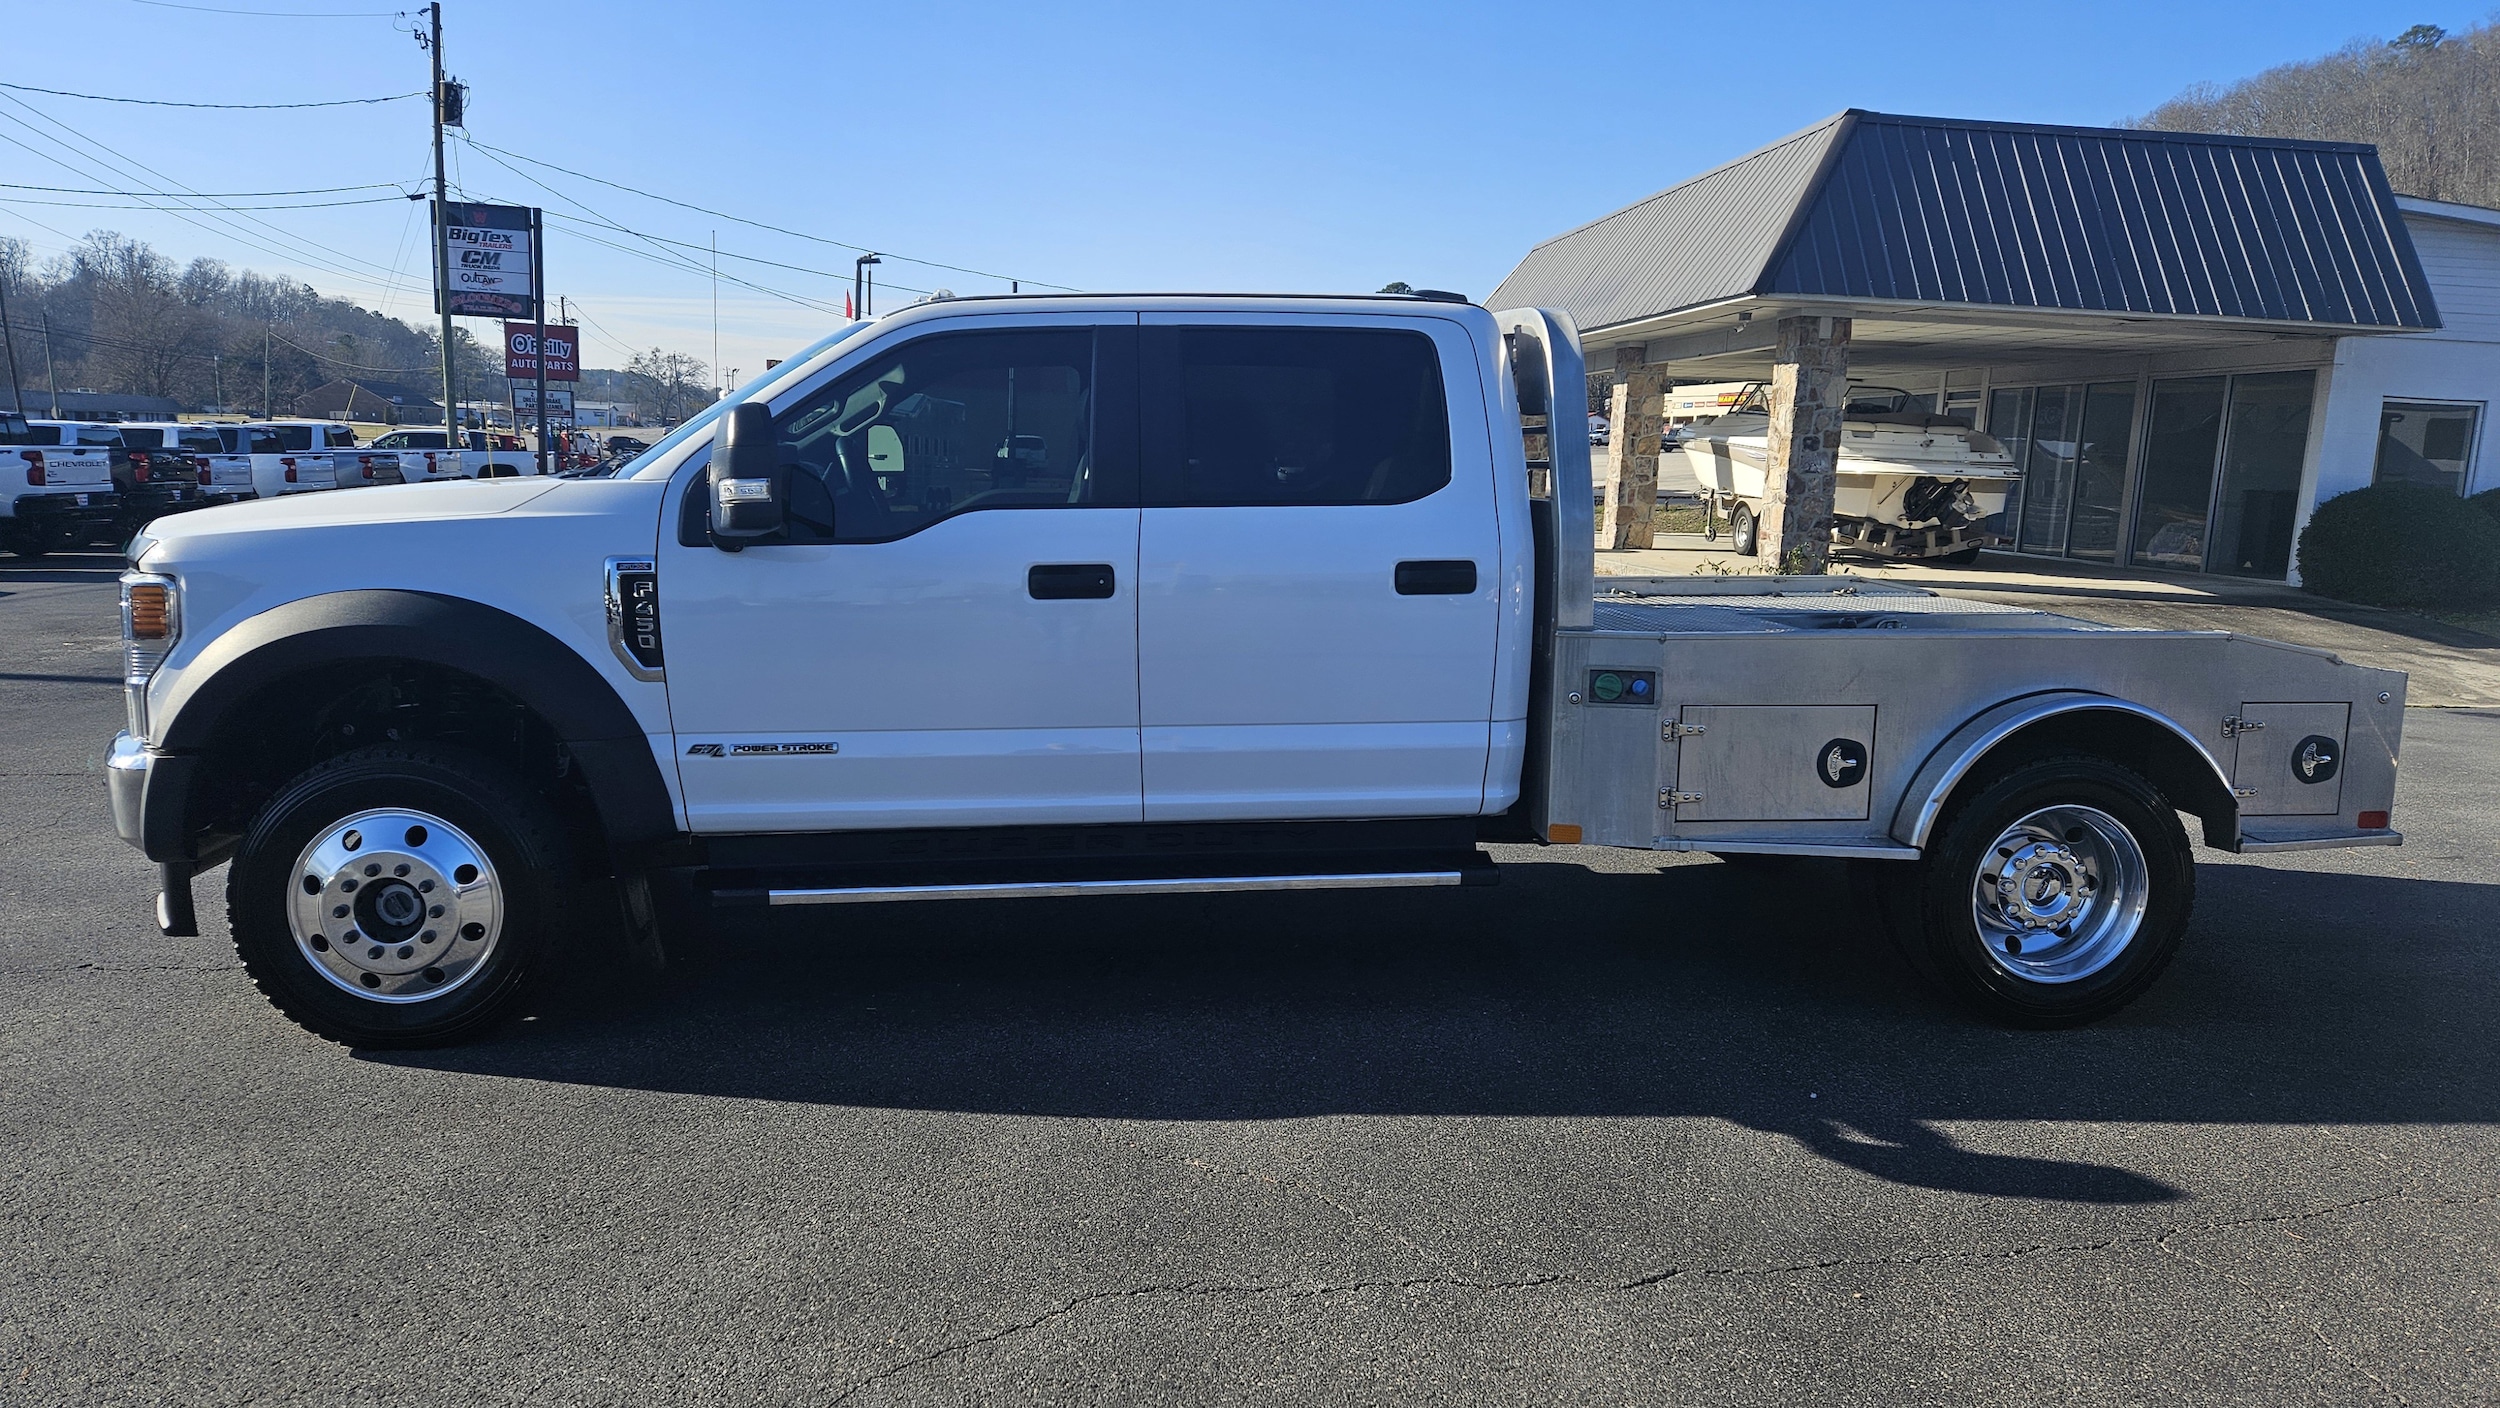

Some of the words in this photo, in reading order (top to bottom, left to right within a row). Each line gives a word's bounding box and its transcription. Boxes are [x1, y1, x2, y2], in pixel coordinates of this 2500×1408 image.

[478, 242, 513, 250] TRAILERS
[461, 250, 502, 266] CM
[511, 359, 537, 369] AUTO
[733, 745, 779, 753] POWER
[781, 743, 834, 752] STROKE
